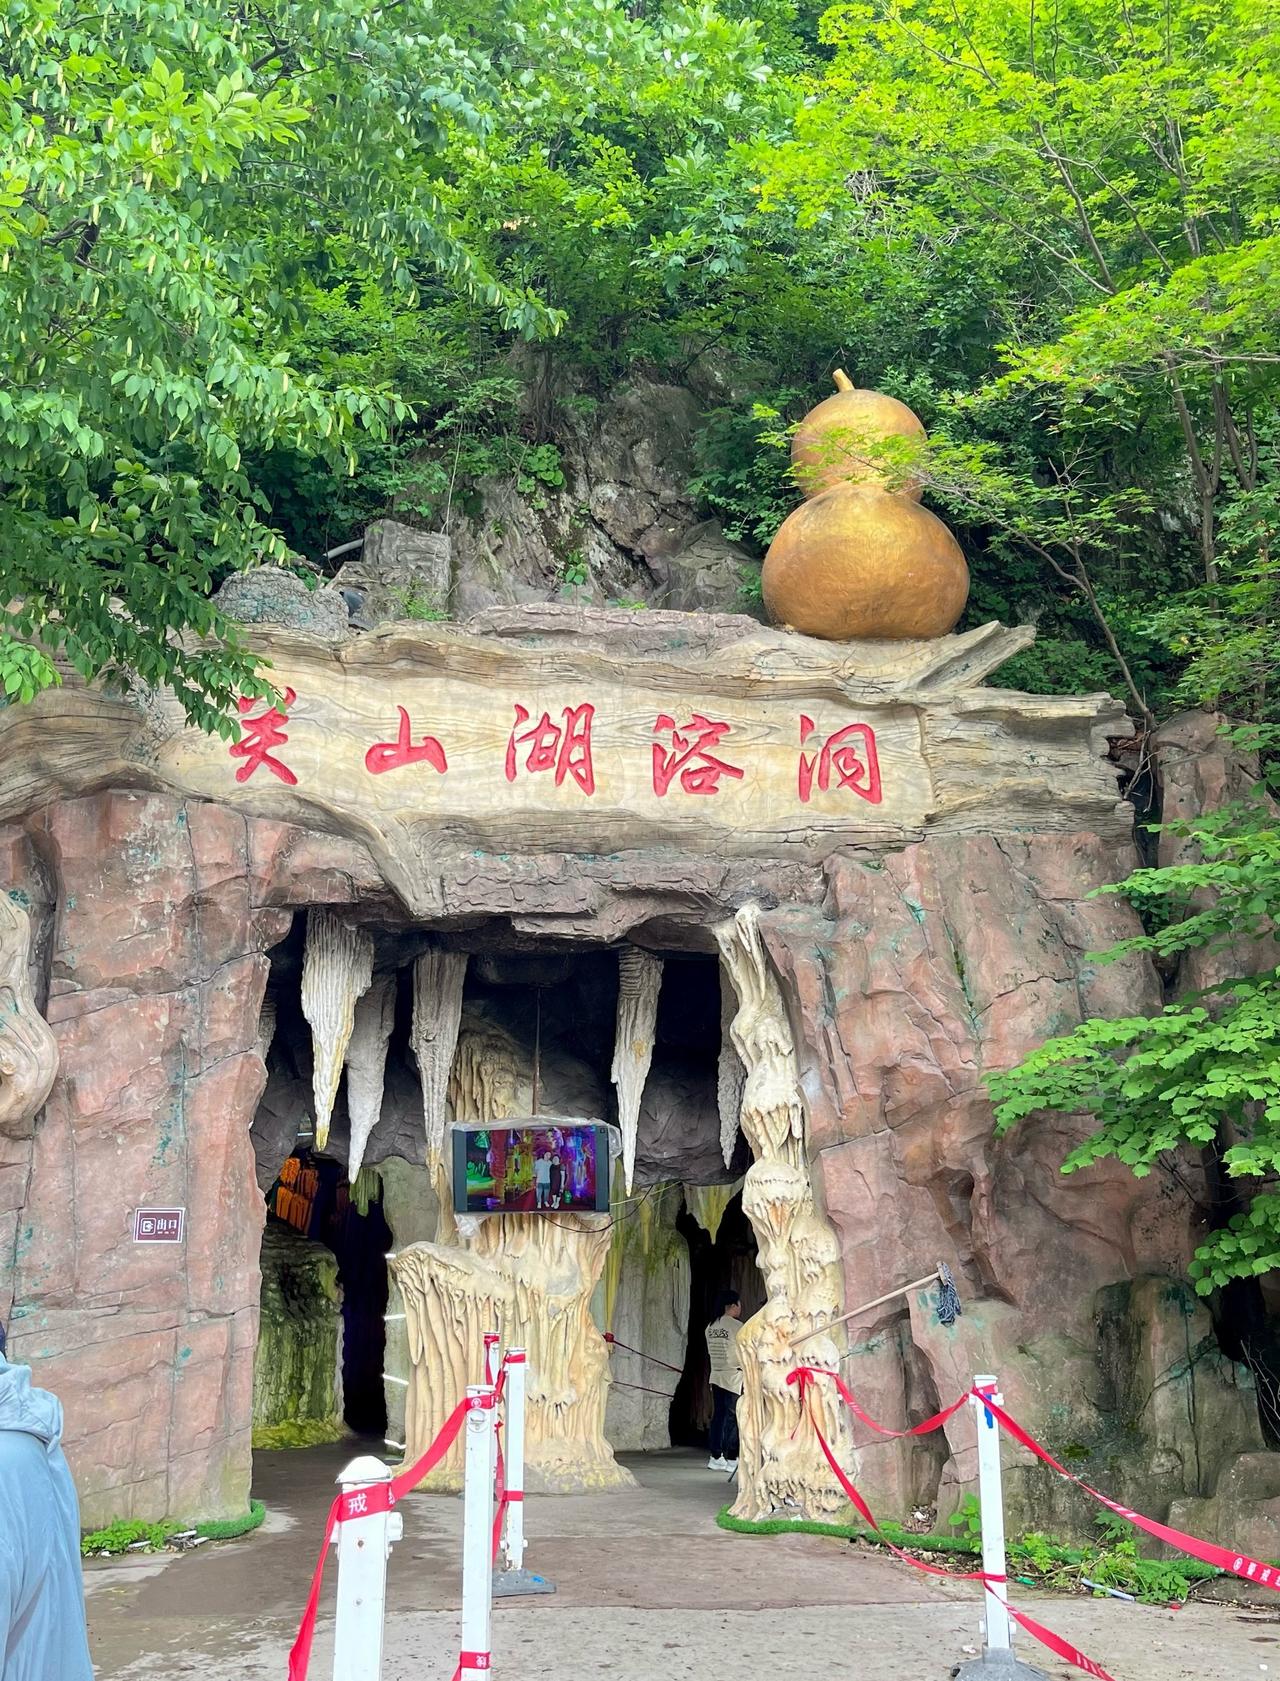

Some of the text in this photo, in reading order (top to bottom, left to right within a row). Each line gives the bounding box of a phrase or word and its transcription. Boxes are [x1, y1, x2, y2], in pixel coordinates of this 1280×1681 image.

[229, 686, 883, 804] 关山湖溶洞
[157, 1218, 177, 1230] 出口
